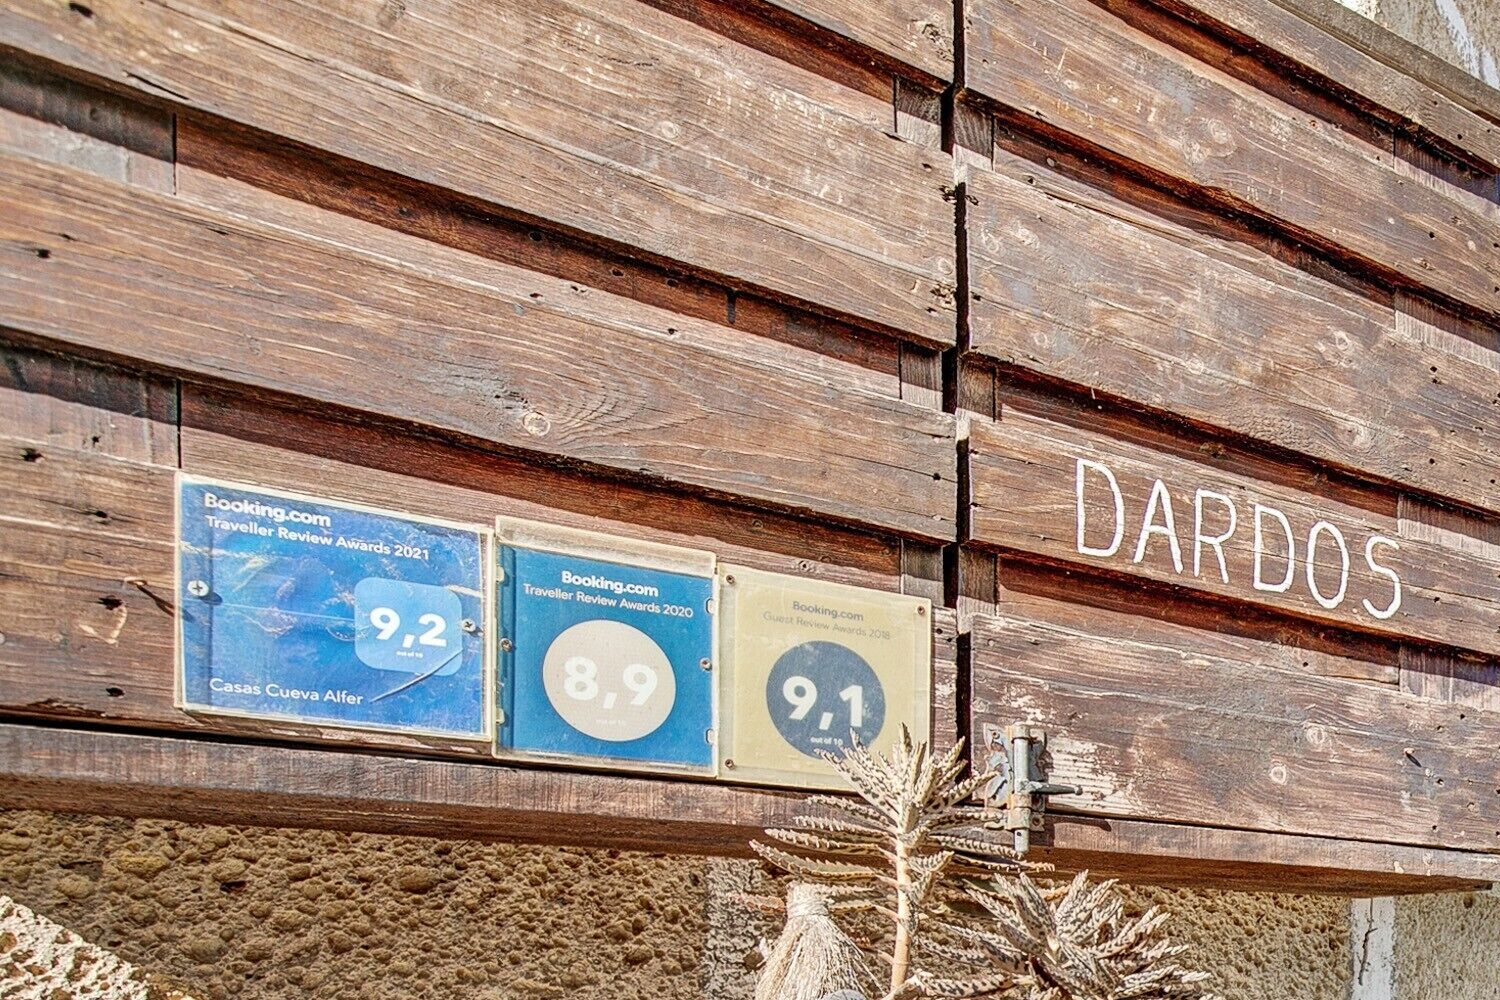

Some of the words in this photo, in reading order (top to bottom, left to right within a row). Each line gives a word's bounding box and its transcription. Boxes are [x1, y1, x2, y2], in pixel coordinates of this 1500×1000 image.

[204, 492, 332, 527] Booking.com
[205, 515, 274, 537] Traveller
[277, 526, 333, 546] Review
[335, 536, 391, 555] Awards
[393, 544, 429, 560] 2021
[1076, 458, 1401, 620] DARDOS
[523, 583, 574, 601] Traveller
[576, 591, 617, 608] Review
[619, 598, 661, 614] Awards
[663, 603, 694, 619] 2020
[561, 570, 659, 598] Booking.com
[369, 606, 448, 648] 9,2
[762, 611, 794, 625] Guest
[796, 616, 830, 631] Review
[832, 622, 867, 637] Awards
[868, 628, 891, 640] 2018
[792, 601, 864, 621] Booking.com
[209, 677, 262, 696] Casas
[265, 683, 320, 701] Cueva
[323, 689, 363, 705] Alfer
[563, 655, 658, 710] 8,9
[782, 675, 863, 731] 9,1
